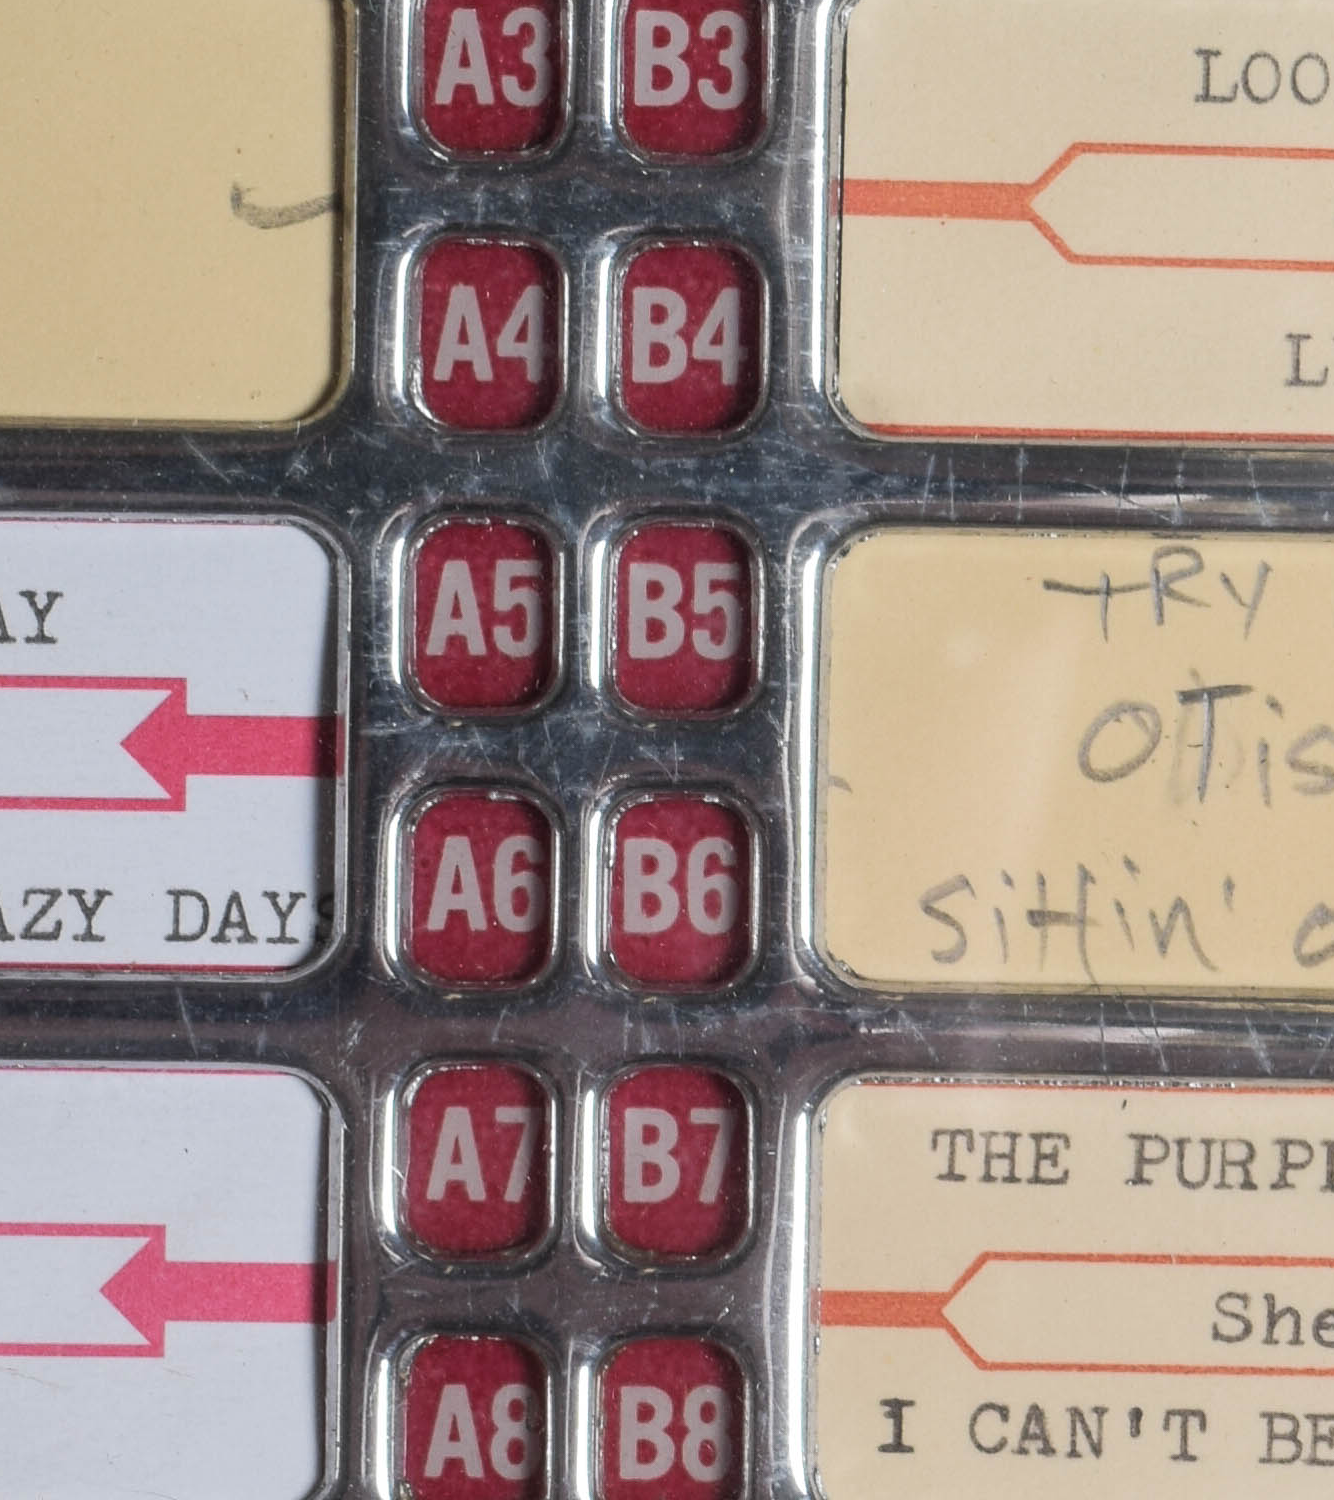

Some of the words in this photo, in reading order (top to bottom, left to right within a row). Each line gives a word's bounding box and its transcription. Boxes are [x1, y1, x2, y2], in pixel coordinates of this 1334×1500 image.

[435, 8, 552, 108] A3
[634, 9, 749, 111] B3
[433, 284, 545, 384] A4
[631, 285, 746, 386] B4
[426, 560, 543, 659] A5
[628, 562, 739, 661] B5
[426, 835, 545, 932] A6
[622, 838, 738, 935] B6
[426, 1106, 539, 1201] A7
[622, 1107, 736, 1204] B7
[931, 1128, 1071, 1186] THE
[424, 1382, 539, 1480] A8
[618, 1384, 732, 1482] B8
[878, 1397, 916, 1454] I
[969, 1402, 1207, 1462] CAN'T
